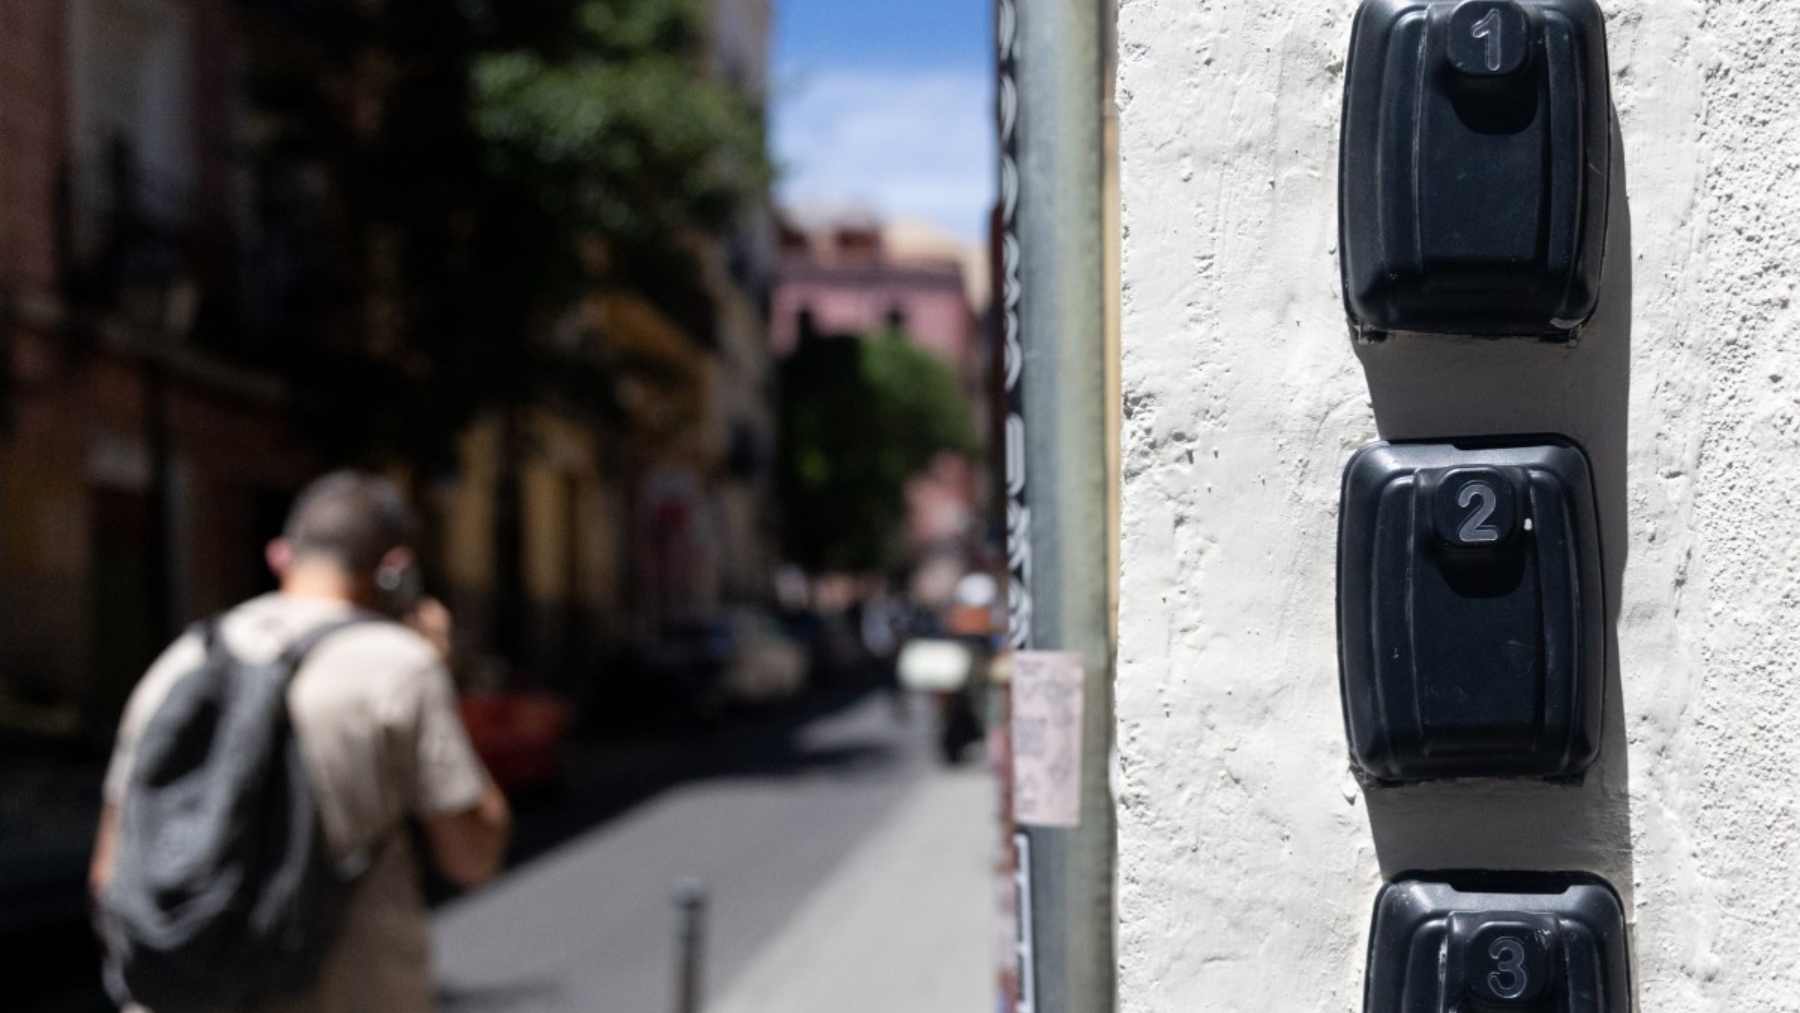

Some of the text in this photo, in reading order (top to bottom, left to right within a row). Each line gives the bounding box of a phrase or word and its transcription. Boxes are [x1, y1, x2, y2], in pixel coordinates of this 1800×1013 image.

[1471, 8, 1502, 71] 1
[1457, 480, 1499, 542] 2
[1487, 935, 1528, 999] 3
